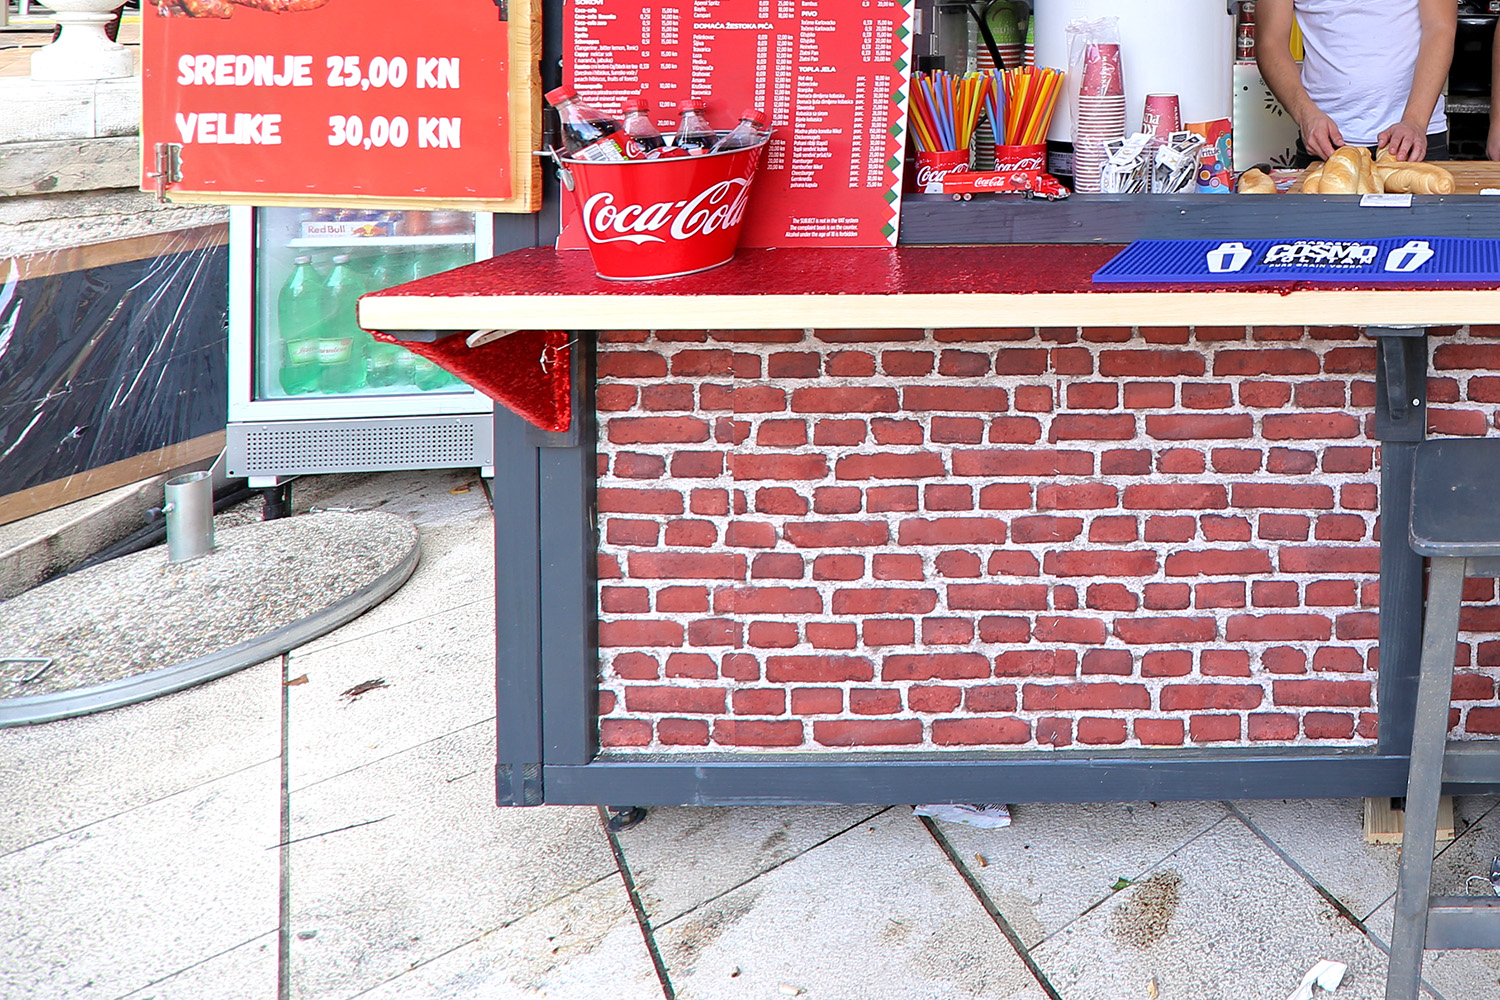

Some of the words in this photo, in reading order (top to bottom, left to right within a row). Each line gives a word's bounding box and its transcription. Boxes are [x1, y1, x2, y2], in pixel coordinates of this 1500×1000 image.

[177, 54, 313, 87] SREDNJE
[326, 54, 408, 92] 25,00
[415, 56, 460, 89] KN
[176, 112, 282, 145] VELIKE
[328, 114, 408, 151] 30,00
[416, 116, 462, 150] KN
[974, 176, 1006, 188] Coca-Cola
[308, 225, 327, 234] Red
[327, 225, 346, 234] Bull
[1266, 244, 1378, 259] COSMO
